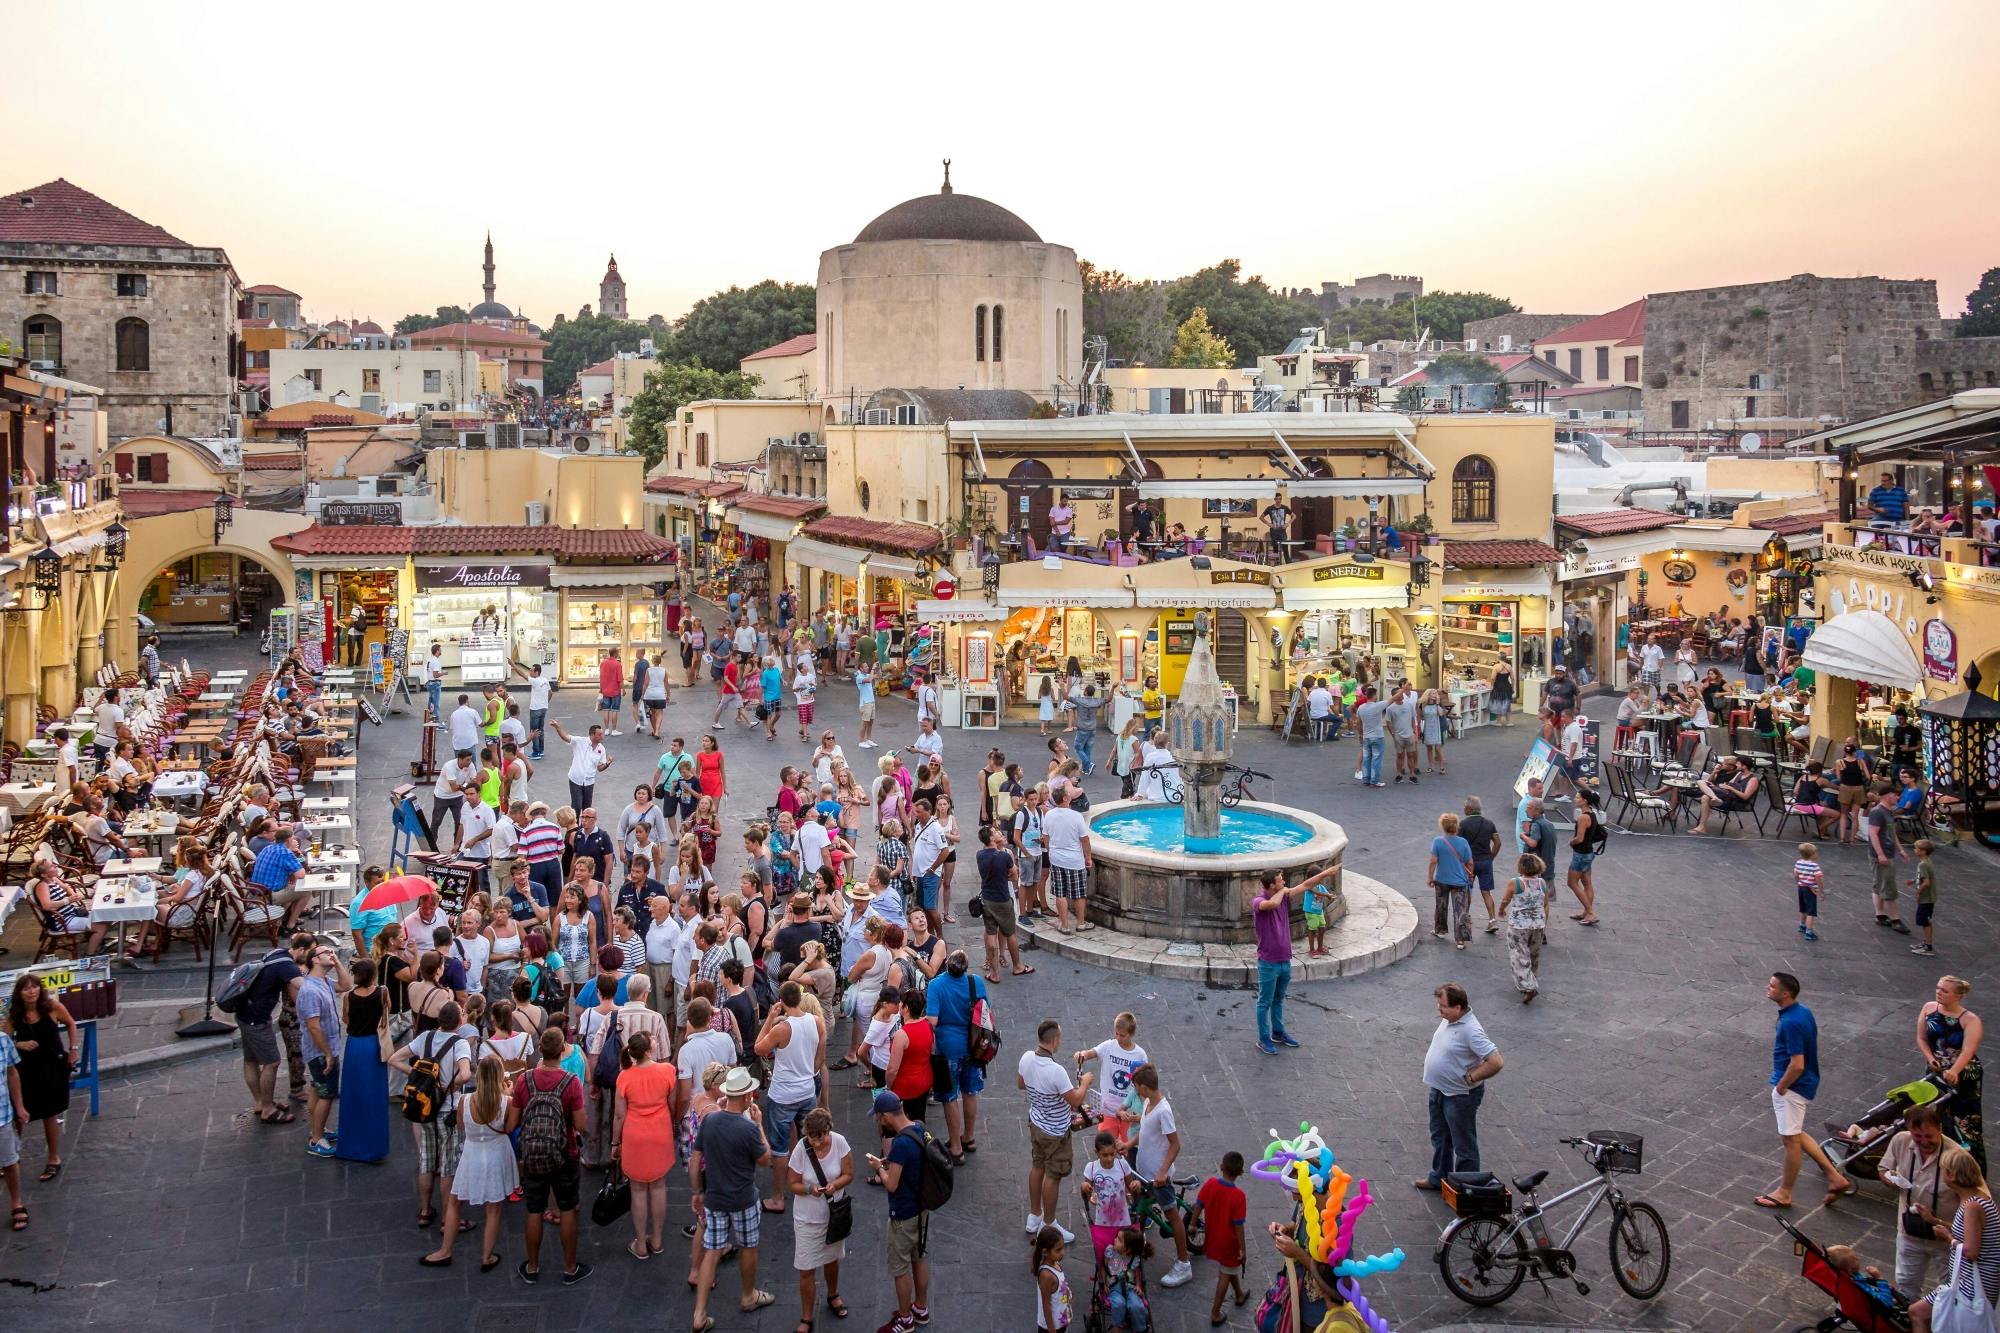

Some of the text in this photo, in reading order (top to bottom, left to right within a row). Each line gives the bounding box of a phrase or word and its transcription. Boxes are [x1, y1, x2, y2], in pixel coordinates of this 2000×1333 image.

[1829, 547, 1923, 573] GREEK STEAK HOUSE
[444, 565, 521, 586] Apostolia
[1329, 566, 1368, 577] NEFELI
[1044, 598, 1088, 606] stigma
[1154, 598, 1251, 607] stigma interfurs
